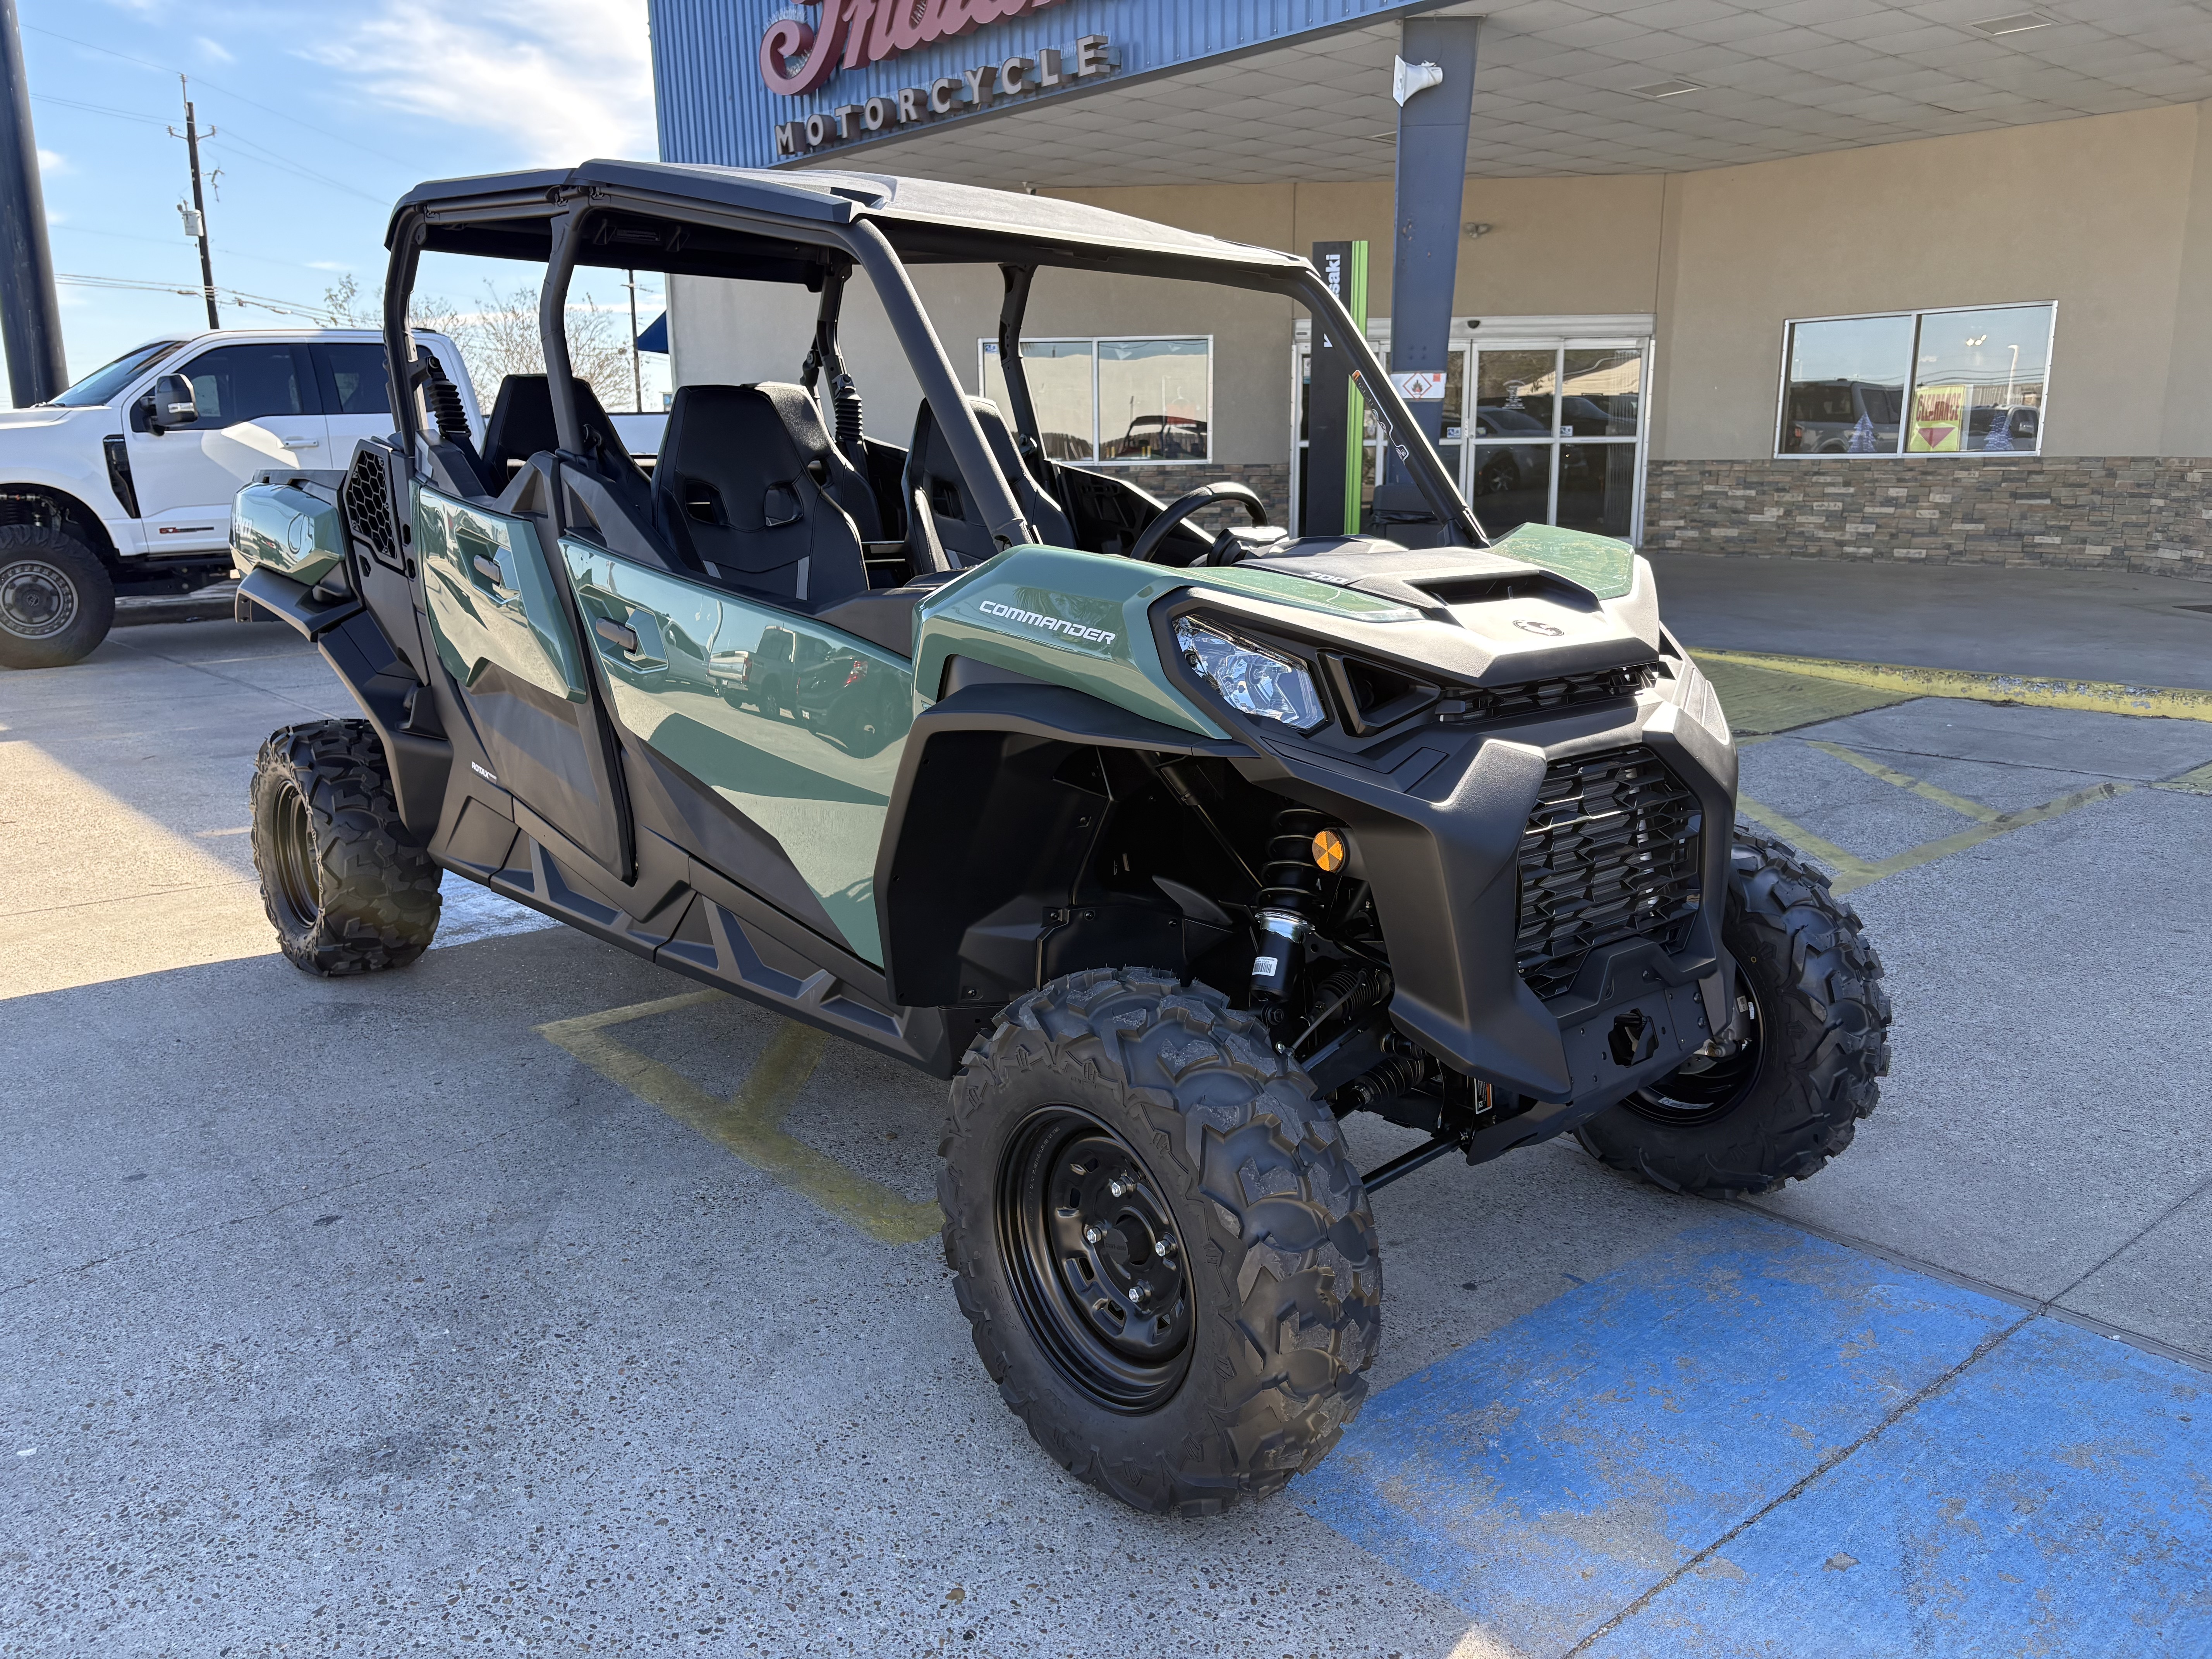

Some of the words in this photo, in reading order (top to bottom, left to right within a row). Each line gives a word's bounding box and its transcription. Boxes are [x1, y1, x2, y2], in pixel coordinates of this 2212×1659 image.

[775, 34, 1110, 155] MOTORCYCLE
[1916, 393, 1961, 421] CLEARANCE
[1305, 571, 1349, 584] 700
[979, 600, 1116, 645] COMMANDER
[471, 761, 489, 779] ROTAX
